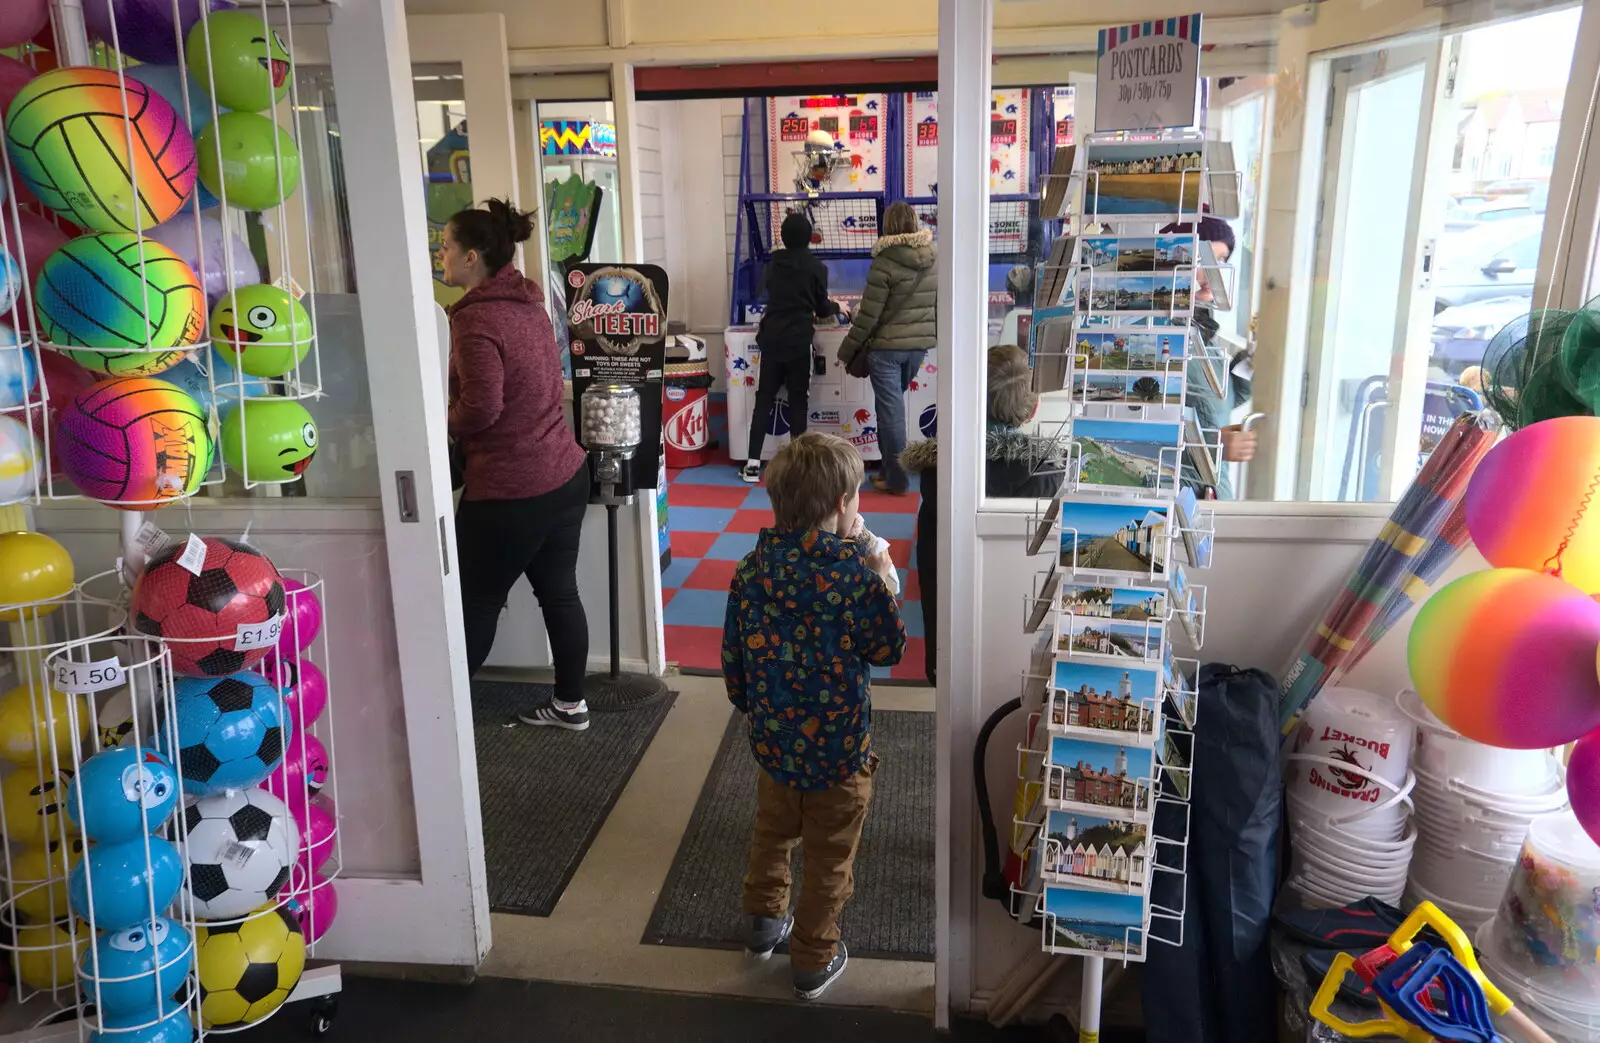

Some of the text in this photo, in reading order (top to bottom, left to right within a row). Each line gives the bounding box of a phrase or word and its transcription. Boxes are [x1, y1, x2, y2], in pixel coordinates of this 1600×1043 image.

[1110, 42, 1184, 80] POSTCARDS
[782, 119, 808, 133] 250
[918, 124, 938, 139] 33
[572, 298, 625, 325] Shark
[594, 312, 659, 336] TEETH
[573, 342, 584, 351] £1
[1426, 414, 1437, 424] IN
[1423, 424, 1446, 436] NOW
[58, 666, 117, 686] £1.50
[1319, 726, 1391, 760] BUCKET
[1308, 767, 1380, 803] CRABBING
